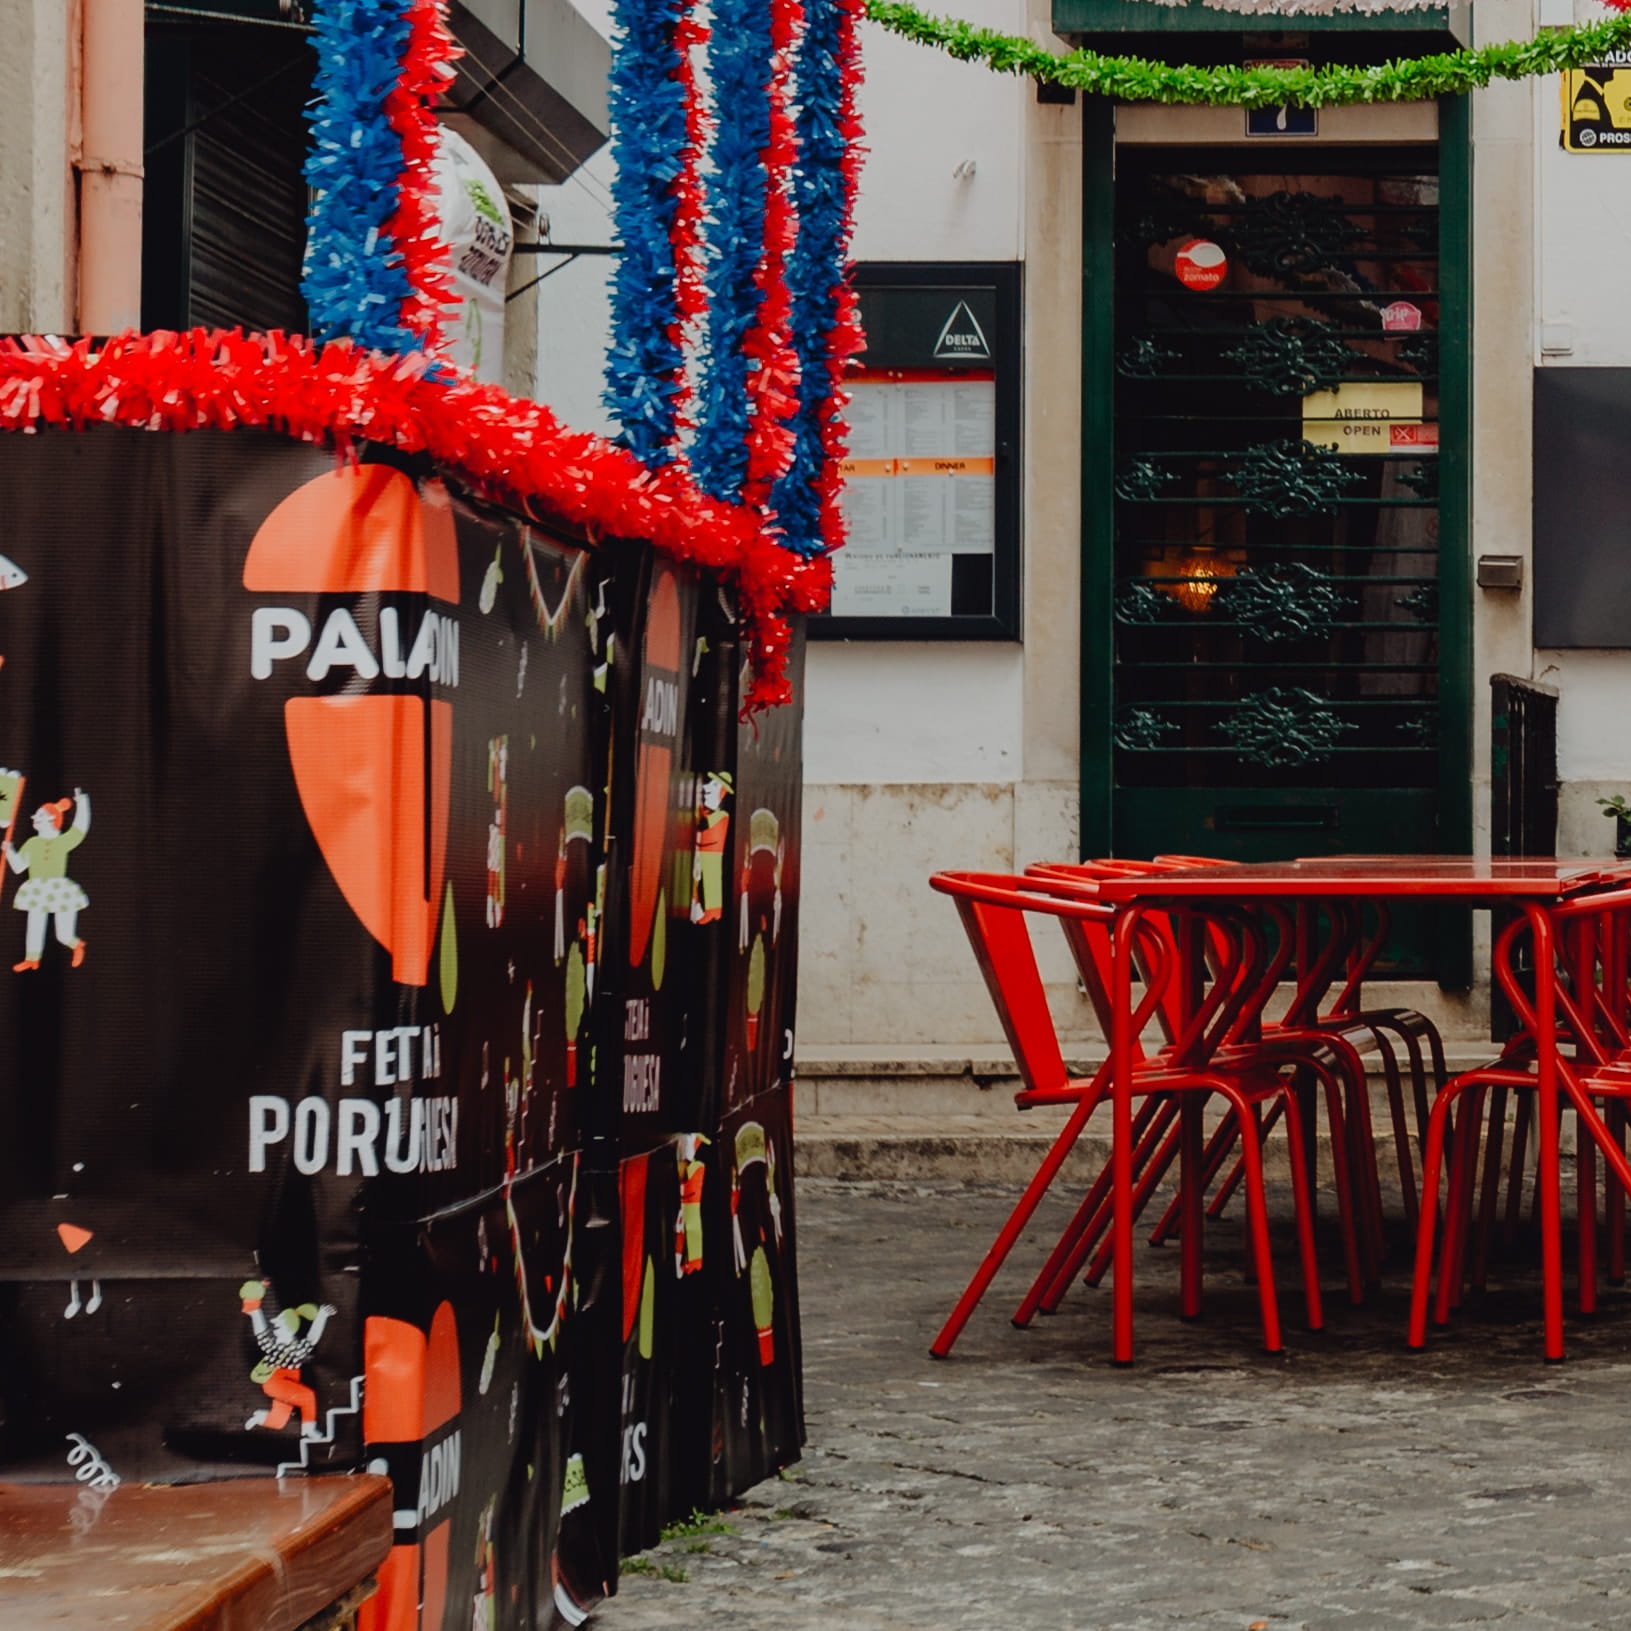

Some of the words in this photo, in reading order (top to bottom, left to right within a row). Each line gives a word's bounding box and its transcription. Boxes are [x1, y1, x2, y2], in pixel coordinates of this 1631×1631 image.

[1183, 272, 1220, 282] zomato
[945, 334, 981, 346] DELTA
[1334, 408, 1390, 418] ABERTO
[1343, 425, 1381, 436] OPEN
[935, 462, 966, 470] DINNER
